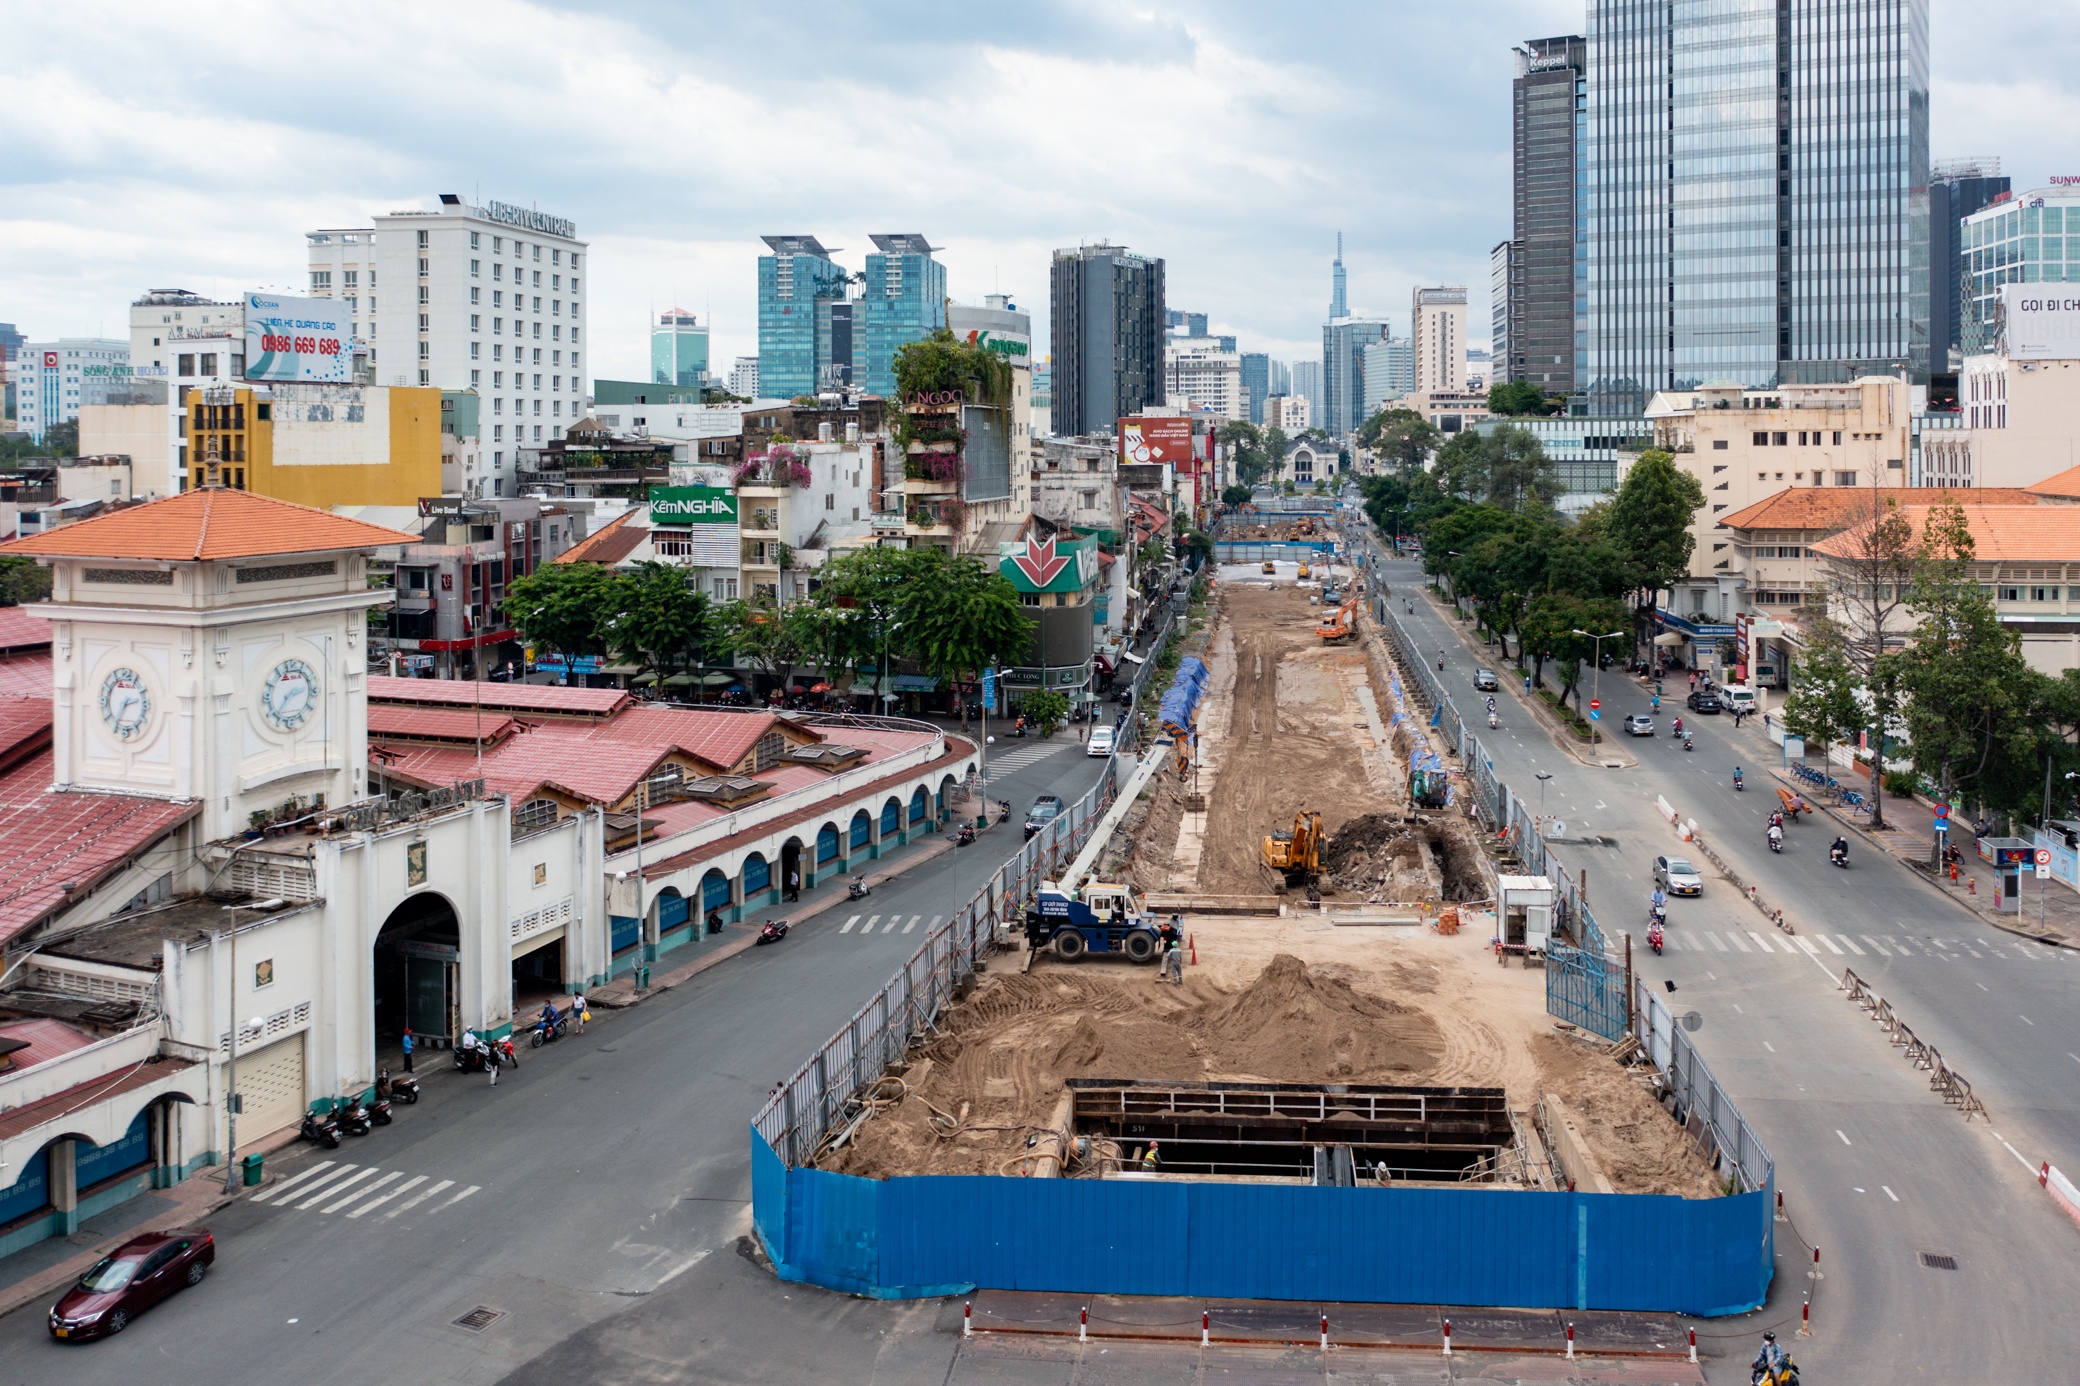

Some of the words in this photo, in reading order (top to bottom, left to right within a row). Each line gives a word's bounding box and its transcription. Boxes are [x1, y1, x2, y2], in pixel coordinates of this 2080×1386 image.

[1530, 55, 1566, 67] Keppel
[2029, 198, 2045, 208] citi
[491, 200, 530, 226] LIBERTY
[530, 211, 570, 237] CENTRAL
[2021, 300, 2043, 313] GỌI
[2047, 300, 2060, 311] ĐI
[261, 334, 291, 353] 0986
[294, 336, 316, 354] 669
[319, 338, 340, 355] 689
[431, 506, 443, 514] Live
[444, 506, 458, 514] Band
[287, 717, 295, 728] 6
[120, 728, 128, 739] 6
